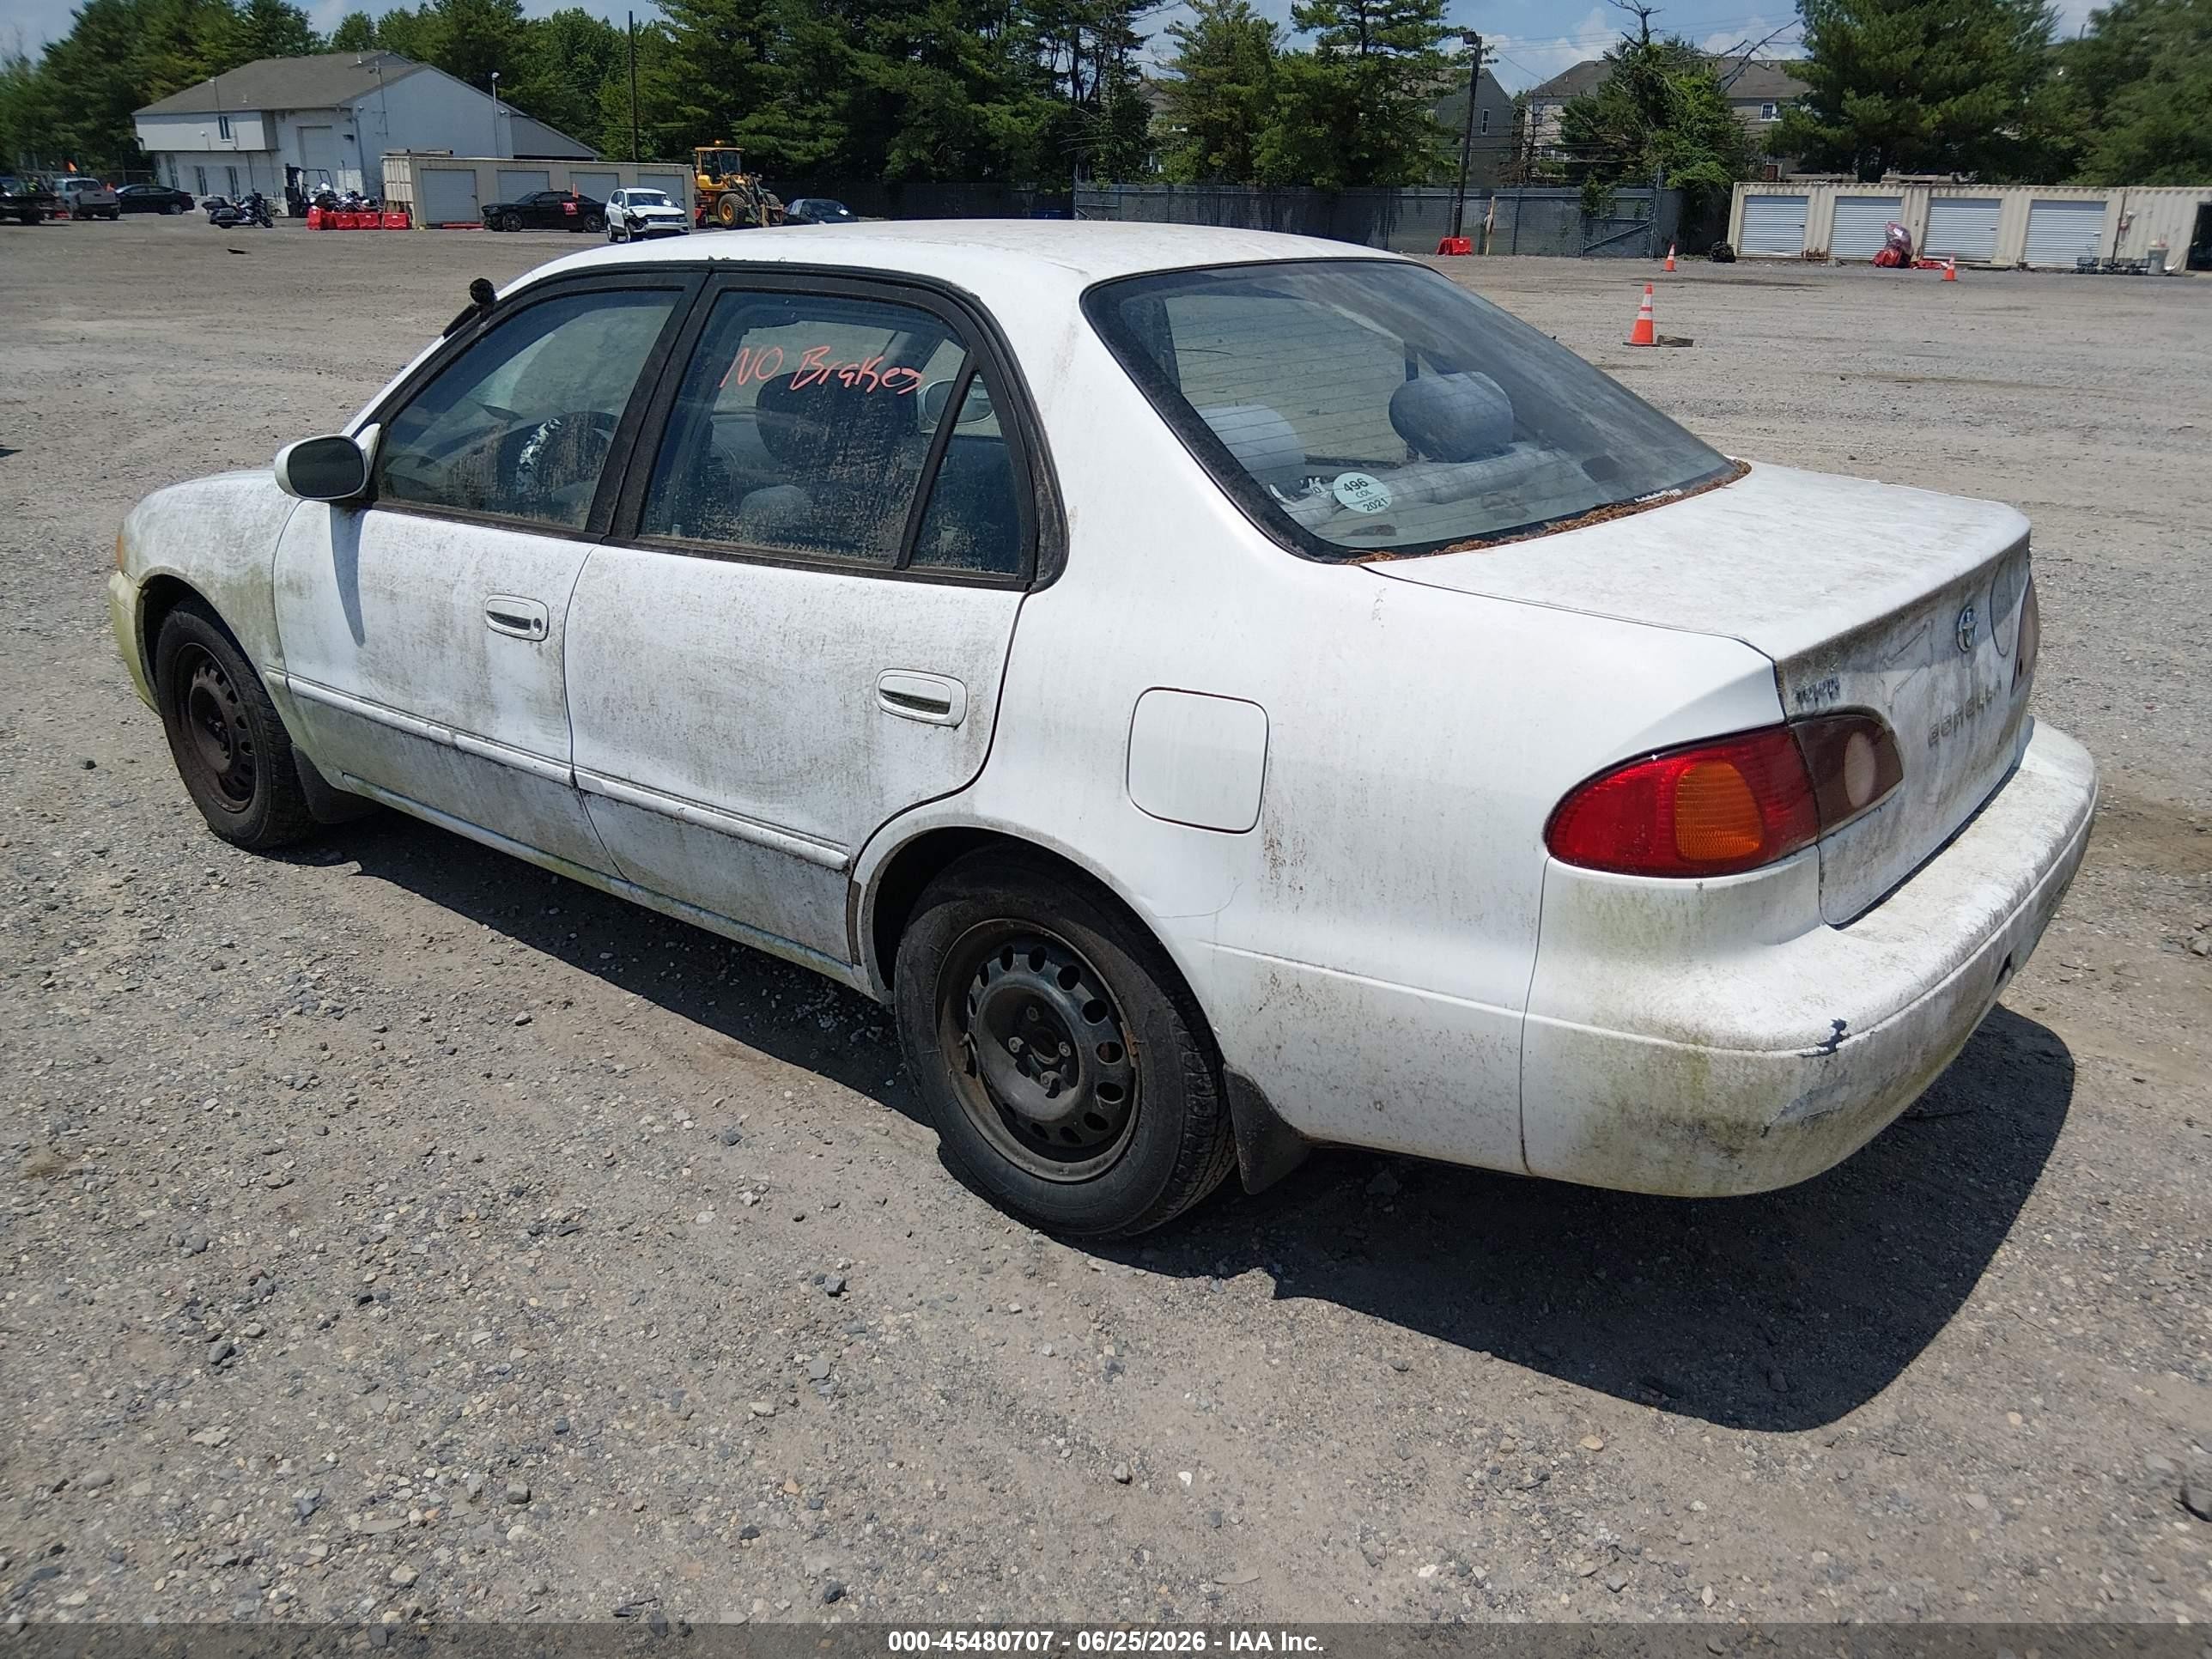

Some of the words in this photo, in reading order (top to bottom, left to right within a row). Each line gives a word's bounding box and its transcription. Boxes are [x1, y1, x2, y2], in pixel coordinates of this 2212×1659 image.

[1343, 477, 1369, 492] 496
[1355, 489, 1373, 498] COL
[1363, 497, 1389, 512] 2021
